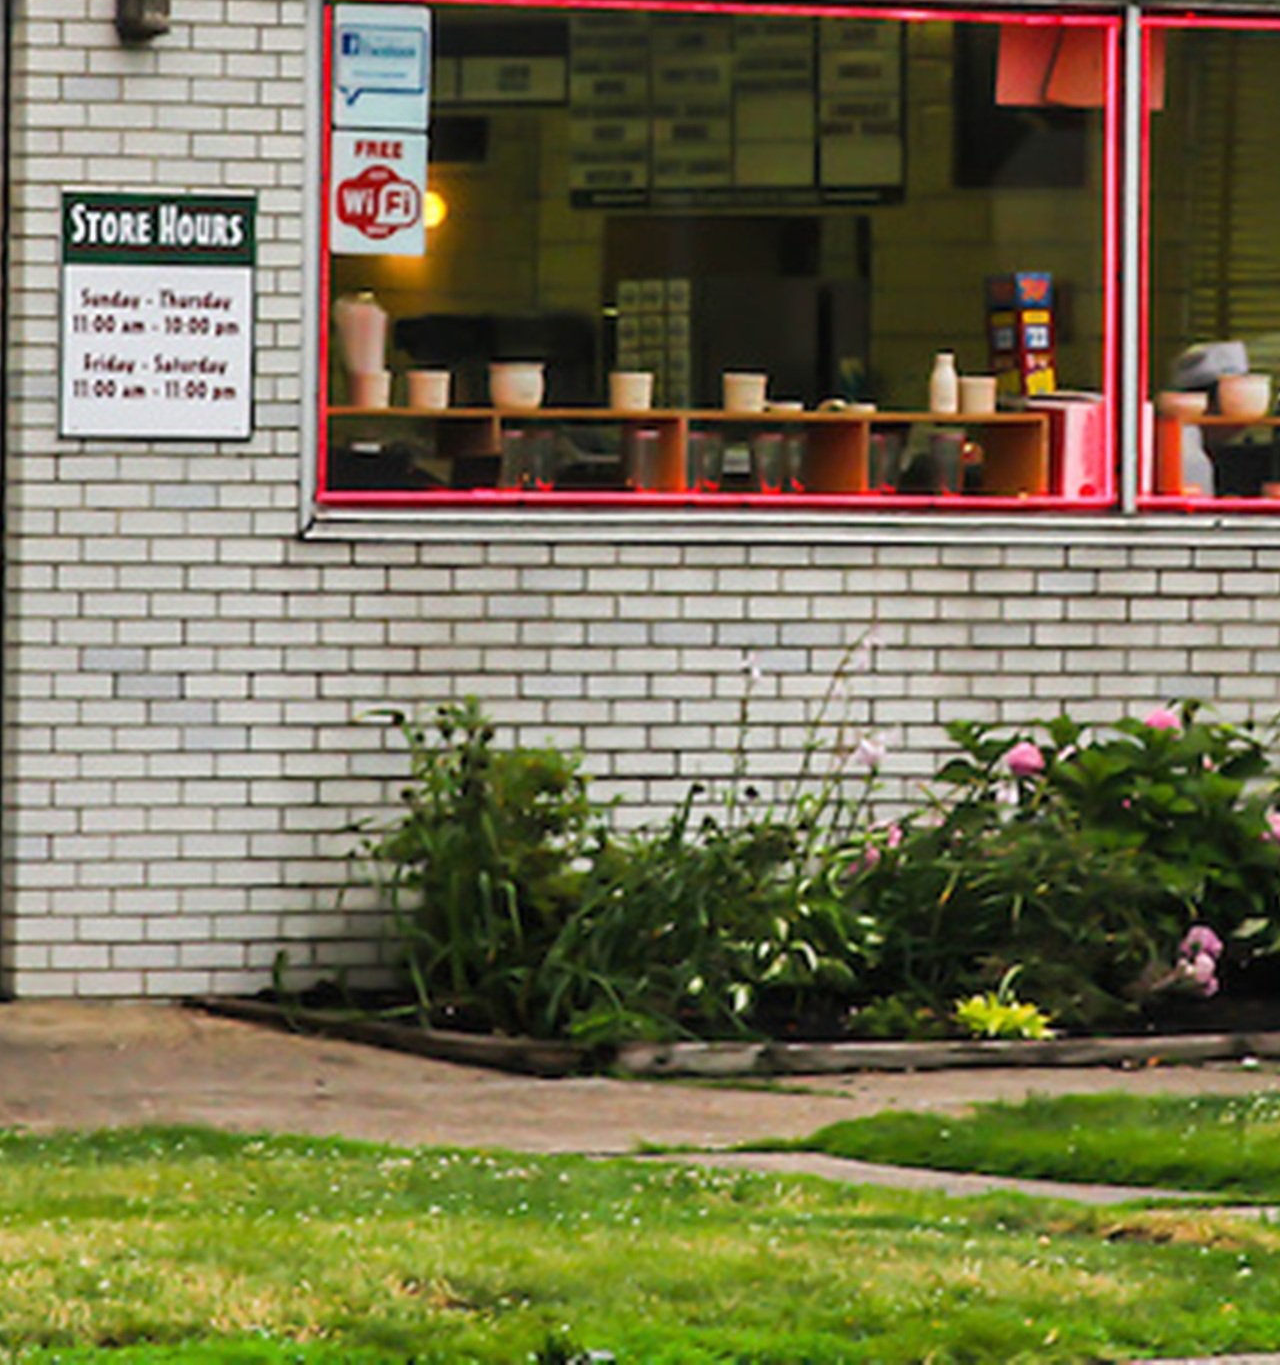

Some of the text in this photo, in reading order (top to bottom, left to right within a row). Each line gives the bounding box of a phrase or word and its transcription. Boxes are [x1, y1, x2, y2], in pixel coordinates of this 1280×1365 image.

[354, 139, 404, 160] FREE
[70, 203, 244, 247] STORE HOURS
[81, 287, 141, 310] Sunday
[159, 288, 233, 313] Thursday
[73, 315, 117, 335] 11:00
[121, 320, 146, 335] am
[164, 316, 211, 336] 10:00
[214, 322, 241, 339] pm
[83, 353, 137, 376] Friday
[153, 353, 229, 377] Saturday
[73, 379, 117, 400] 11:00
[122, 385, 148, 400] am
[164, 380, 210, 401] 11:00
[211, 386, 238, 403] pm
